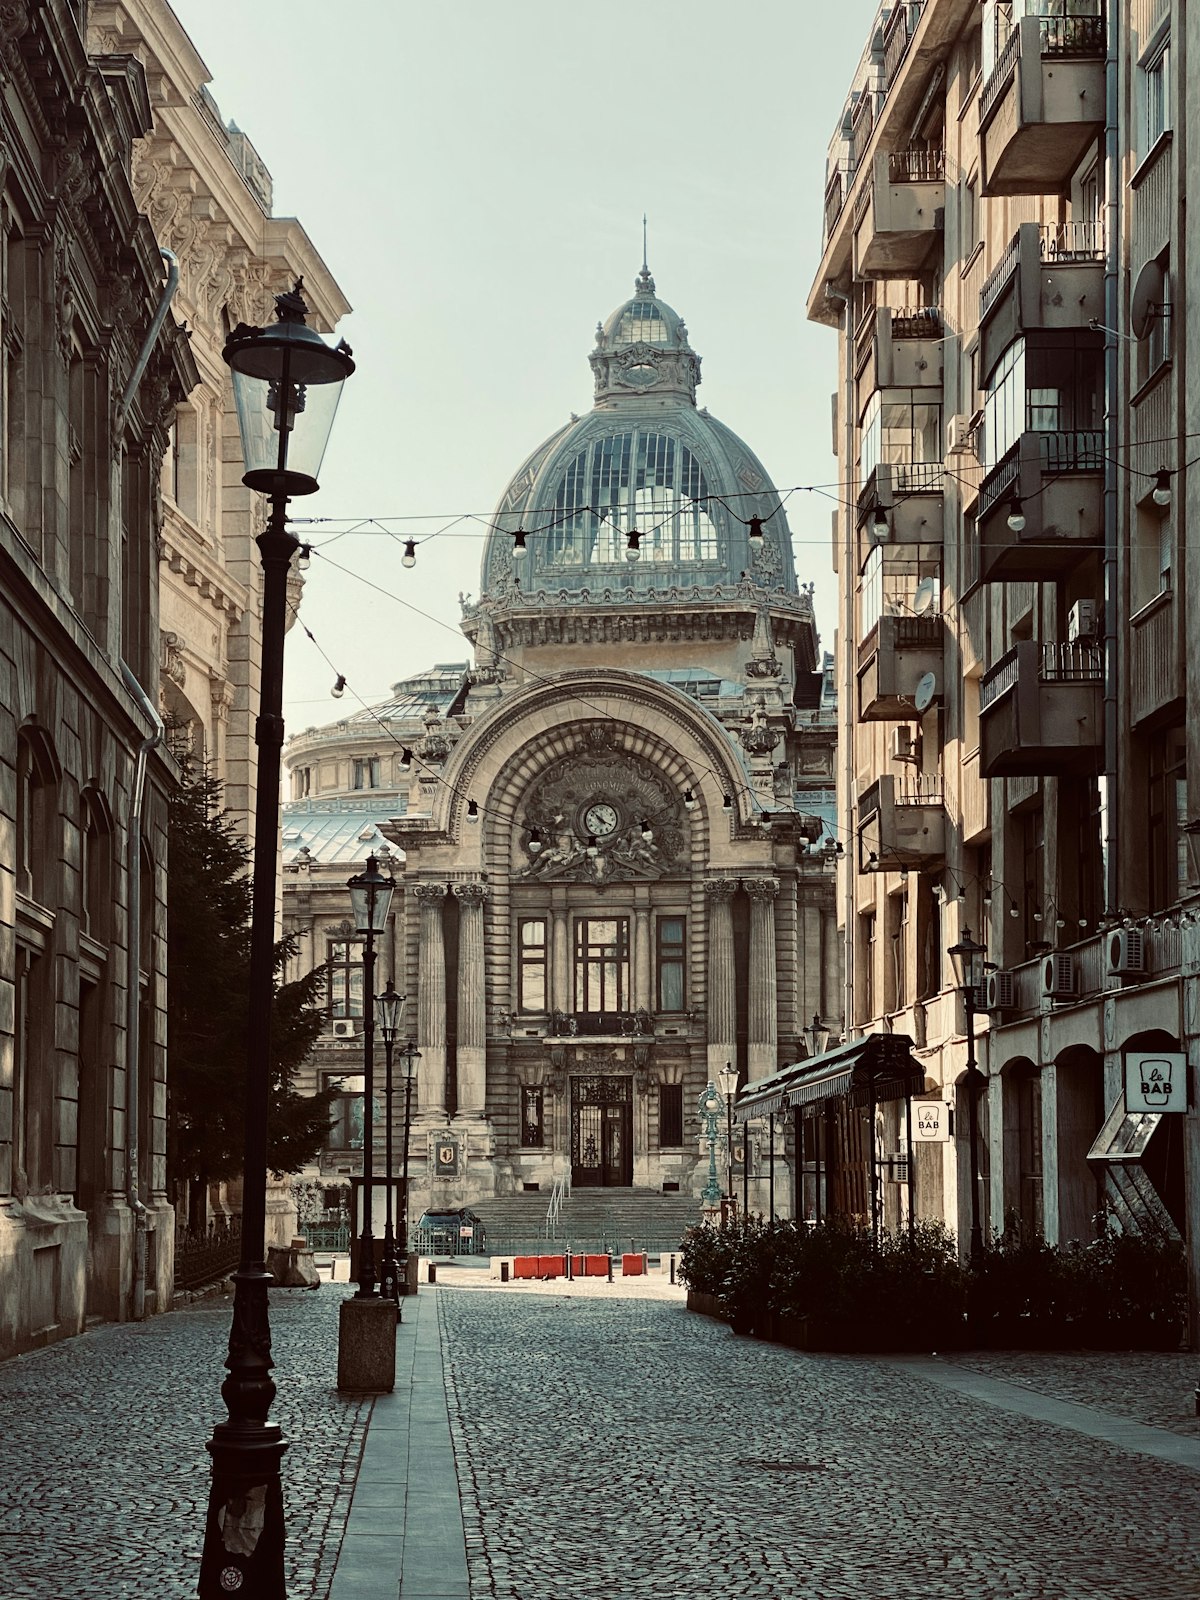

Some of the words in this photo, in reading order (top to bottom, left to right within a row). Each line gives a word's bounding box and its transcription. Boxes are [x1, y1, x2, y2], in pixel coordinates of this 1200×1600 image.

[1149, 1068, 1164, 1081] le
[1141, 1083, 1172, 1094] BAB
[924, 1111, 934, 1121] le
[918, 1121, 939, 1129] BAB
